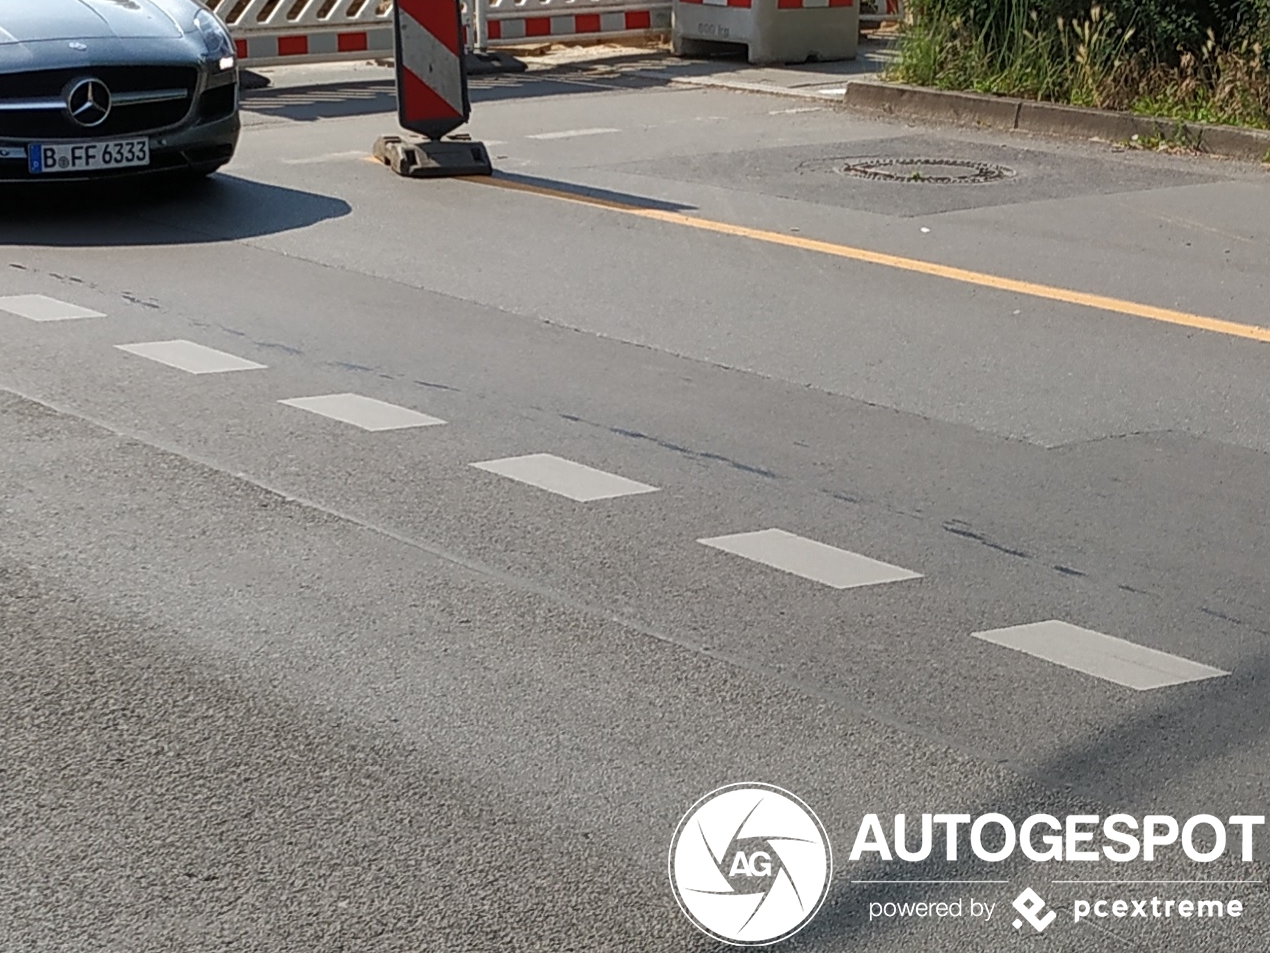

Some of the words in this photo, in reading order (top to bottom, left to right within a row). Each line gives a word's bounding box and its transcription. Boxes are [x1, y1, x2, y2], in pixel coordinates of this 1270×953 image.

[43, 148, 56, 168] B
[71, 146, 97, 167] FF
[102, 141, 146, 164] 6333
